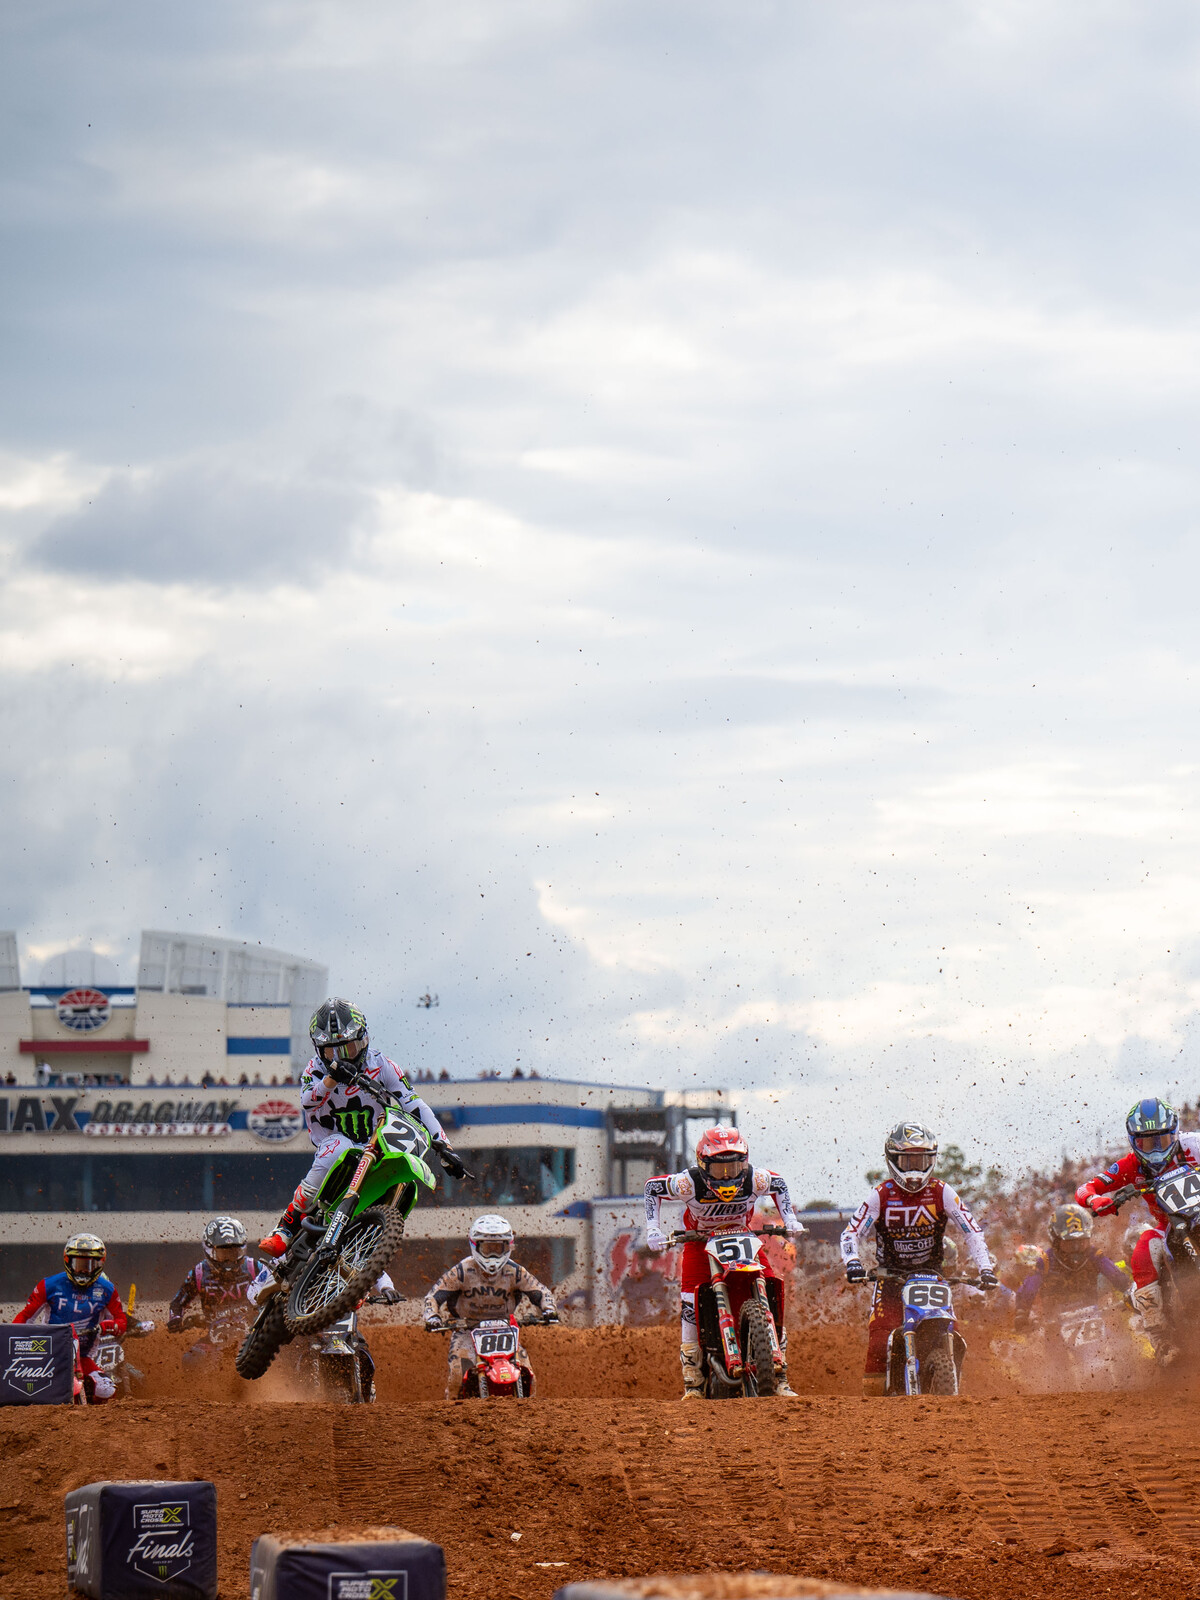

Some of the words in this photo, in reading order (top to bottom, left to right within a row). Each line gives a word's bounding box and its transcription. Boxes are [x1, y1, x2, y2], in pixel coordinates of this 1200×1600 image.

[88, 1101, 238, 1123] DRAGWAY
[325, 1211, 343, 1244] DUNLOP
[714, 1236, 753, 1263] 51
[58, 1297, 99, 1314] FLY
[908, 1285, 949, 1307] 69
[480, 1334, 513, 1354] 80
[2, 1357, 56, 1380] Finals
[126, 1529, 195, 1563] Finals
